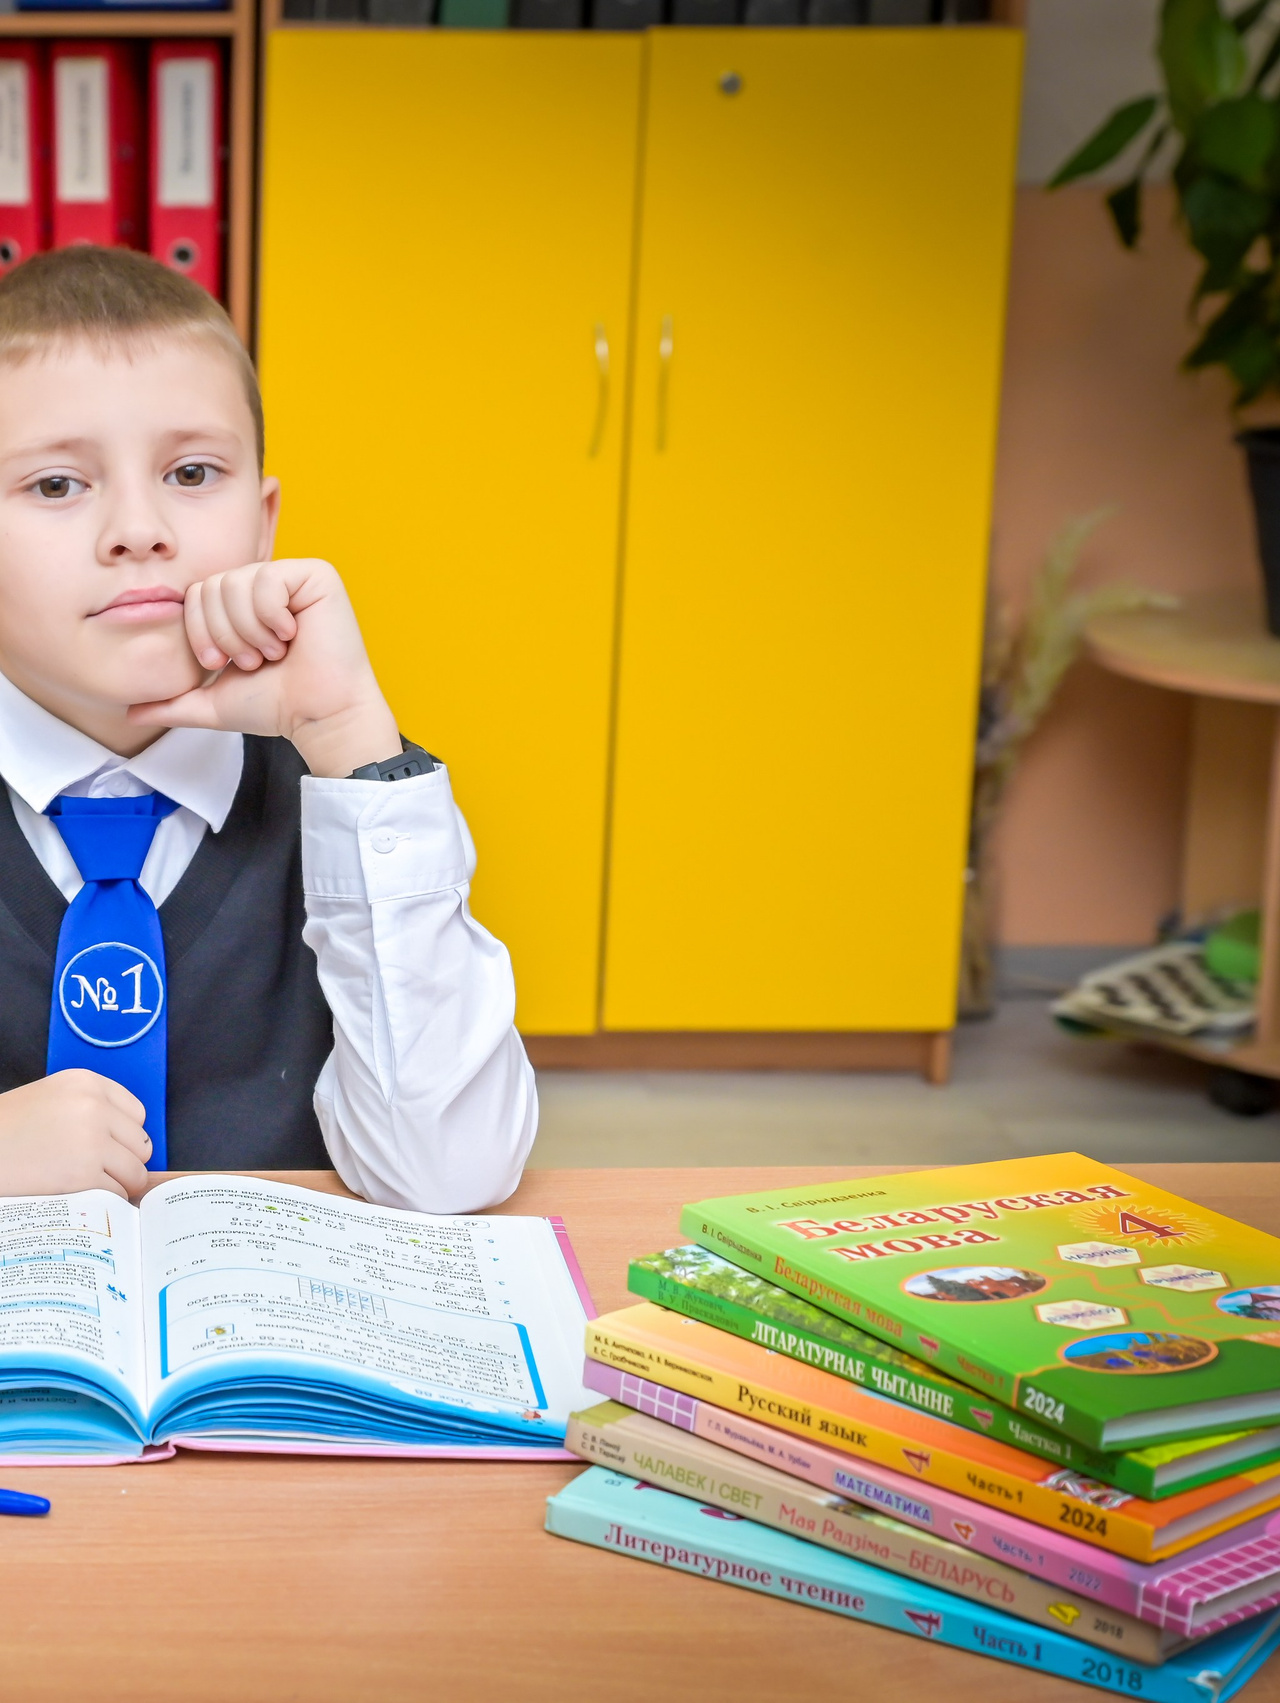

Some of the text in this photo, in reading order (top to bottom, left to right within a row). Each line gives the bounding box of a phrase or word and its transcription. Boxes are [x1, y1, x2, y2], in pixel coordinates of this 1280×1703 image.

[777, 1184, 1131, 1241] Беларуская
[784, 1190, 887, 1210] Свірыдзенка
[1120, 1211, 1185, 1239] 4
[74, 1251, 109, 1262] Минск
[701, 1224, 710, 1236] В.
[716, 1231, 763, 1262] Свірыдзенка
[828, 1228, 1000, 1262] мова
[432, 1289, 486, 1301] Вычисли
[432, 1302, 490, 1315] Вычисли.
[773, 1255, 862, 1316] Беларуская
[865, 1308, 903, 1339] мова
[1024, 1386, 1065, 1425] 2024
[751, 1320, 866, 1382] ЛІТАРАТУРНАЕ
[871, 1366, 954, 1418] ЧЫТАННЕ
[1009, 1420, 1061, 1456] Частка
[1065, 1444, 1072, 1460] 1
[633, 1451, 706, 1492] ЧАЛАВЕК
[718, 1482, 764, 1511] СВЕТ
[737, 1384, 1108, 1538] Русский язык 4 Часть 1 2024
[778, 1503, 816, 1532] Мая
[908, 1549, 1016, 1605] БЕЛАРУСЬ
[835, 1471, 1102, 1592] МАТЕМАТИКА 4 Часть 1 2022
[604, 1523, 1143, 1692] Литературное чтение 4 Часть 1 2018
